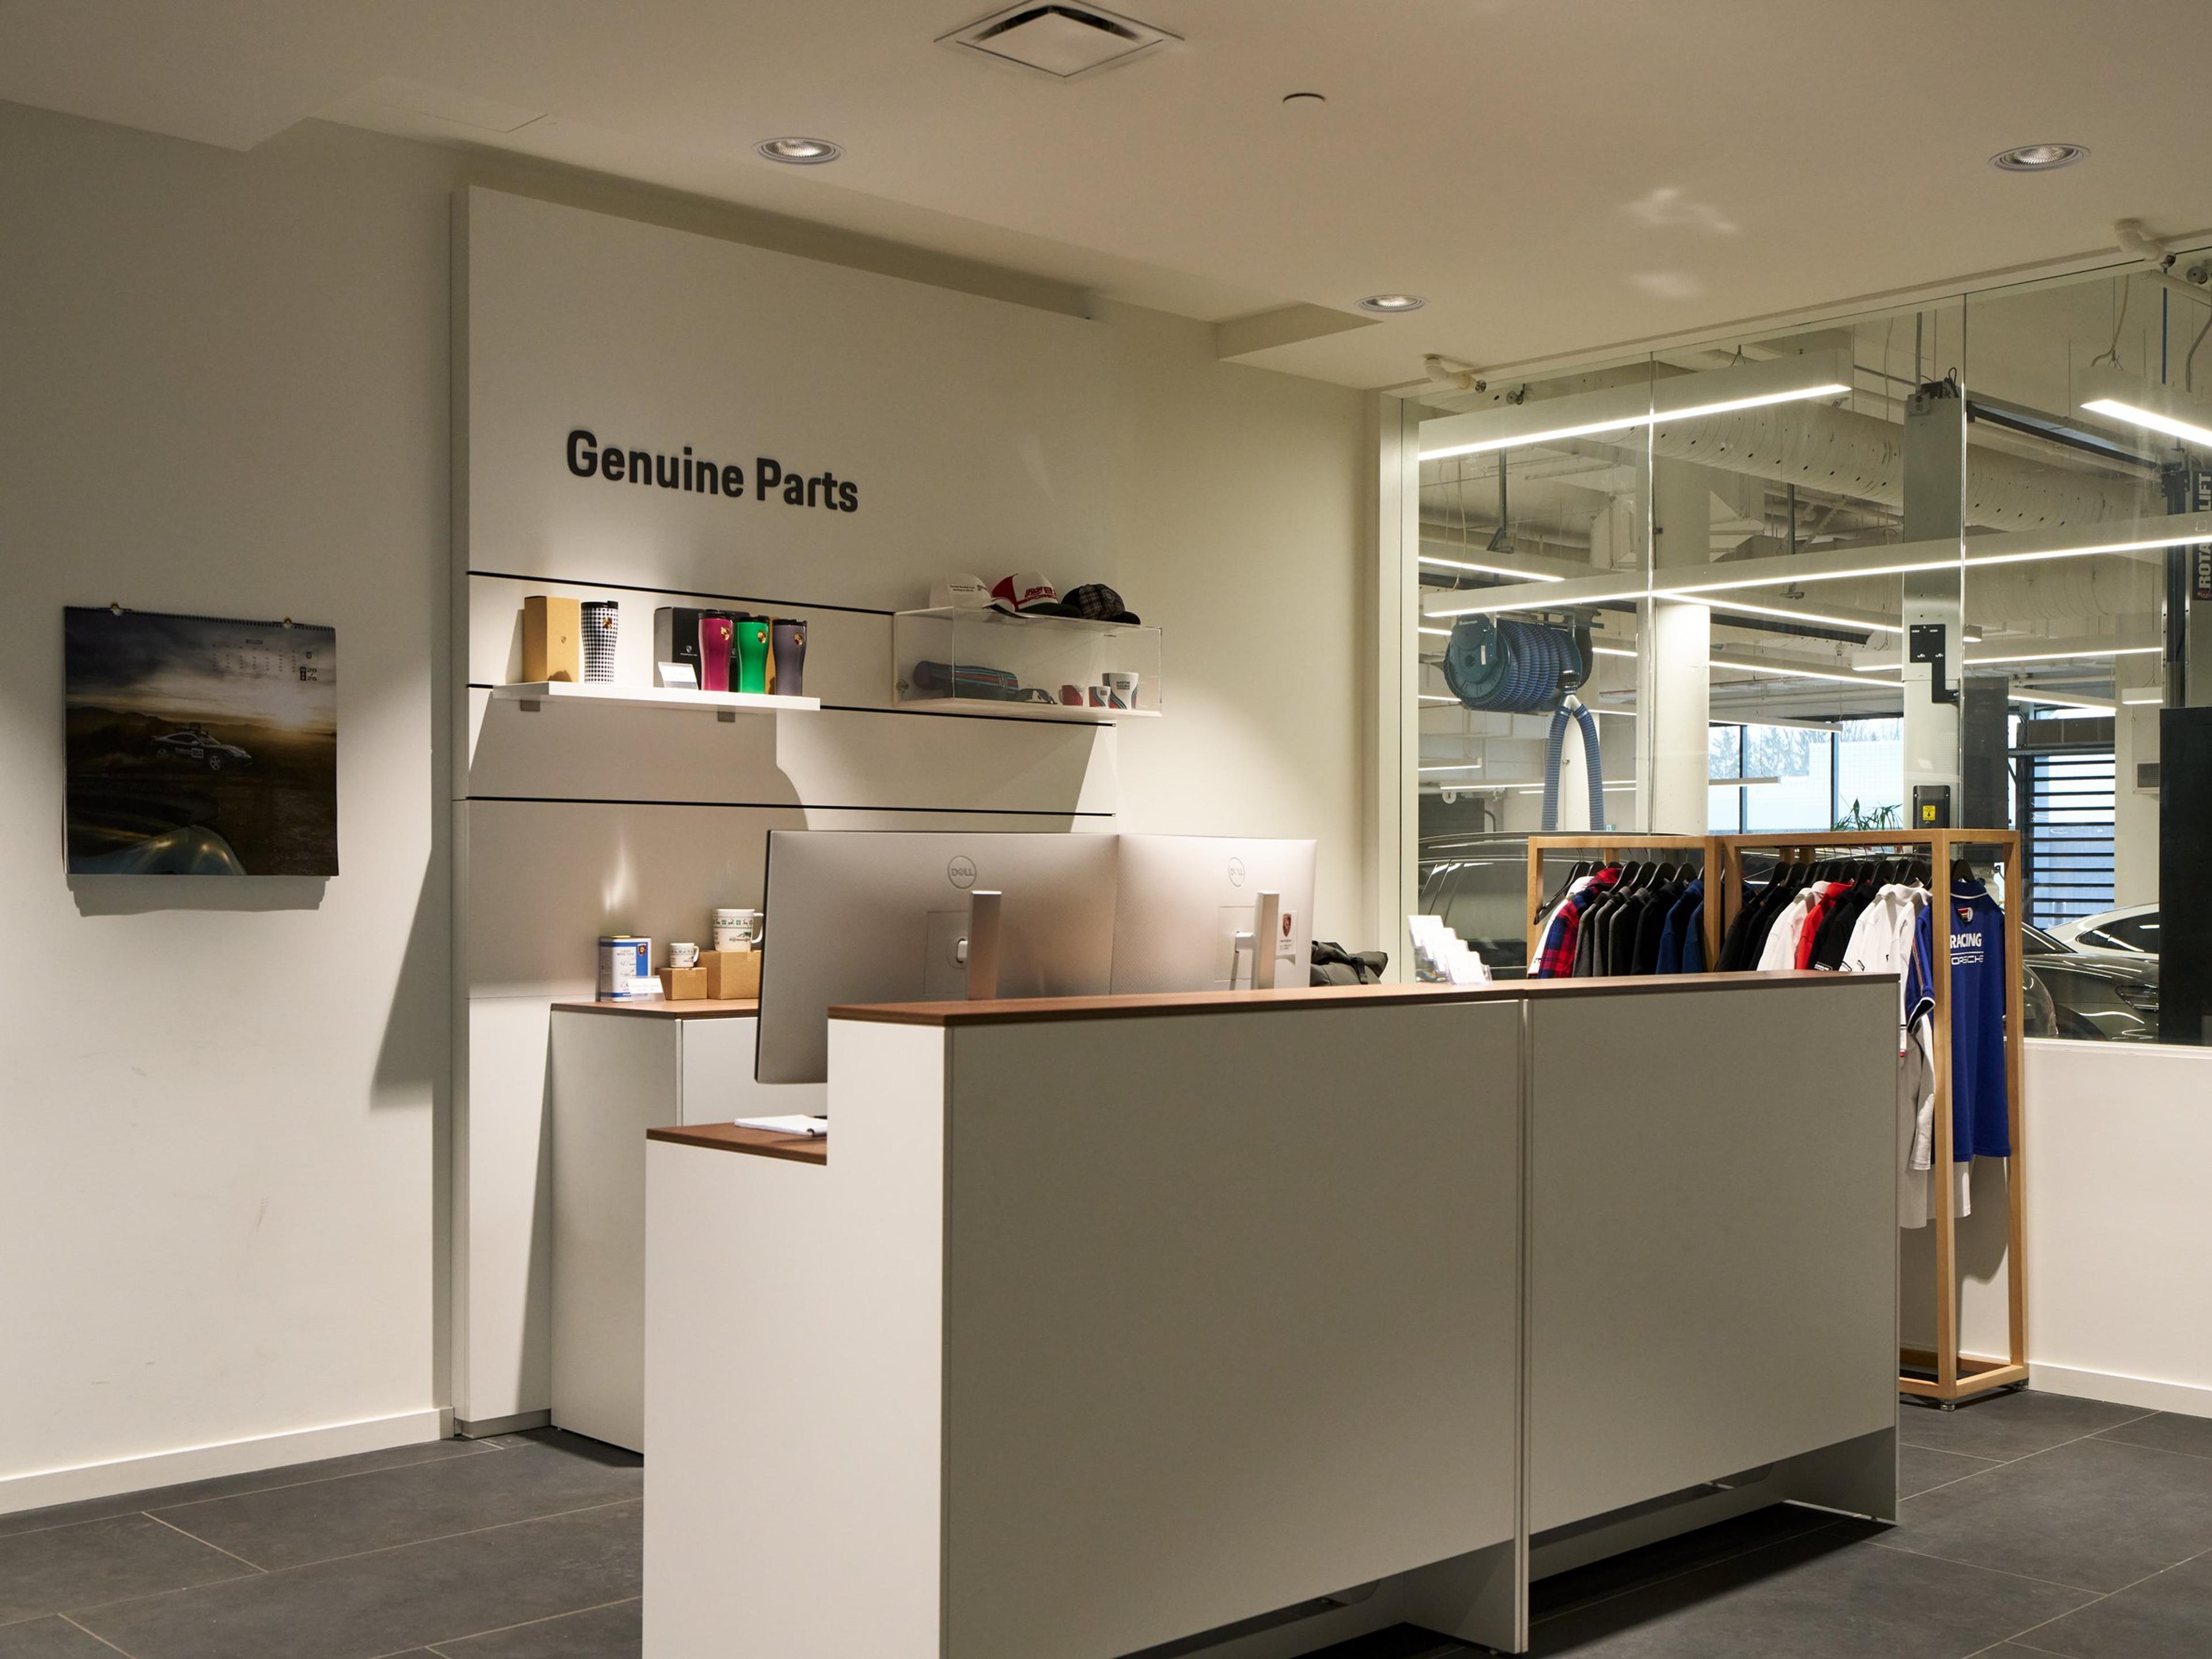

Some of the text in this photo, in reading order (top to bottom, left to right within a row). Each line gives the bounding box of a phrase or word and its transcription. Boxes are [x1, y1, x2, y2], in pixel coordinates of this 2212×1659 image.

[567, 429, 858, 513] Genuine Parts
[2198, 473, 2211, 588] ROTA LIFT
[951, 868, 974, 877] DELL
[1950, 933, 1982, 949] RACING
[1951, 955, 1984, 965] ORSCHE
